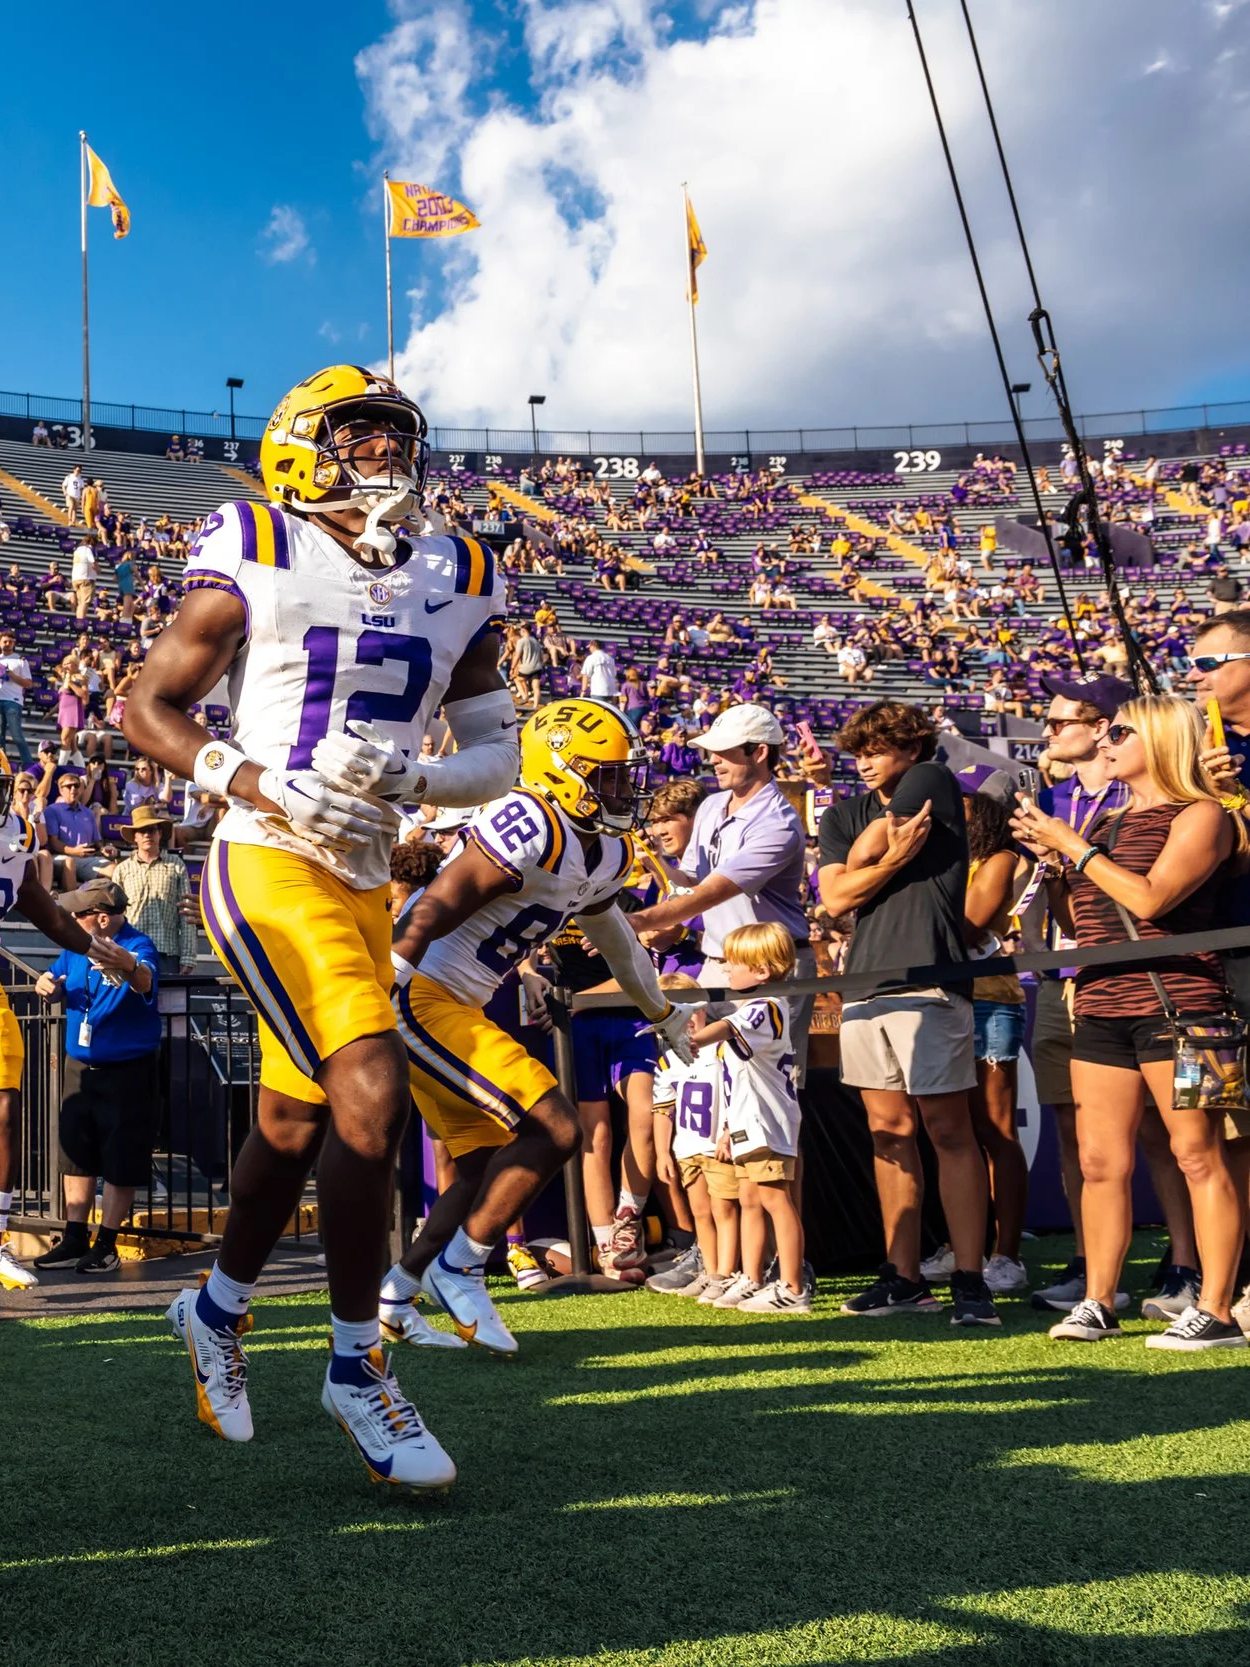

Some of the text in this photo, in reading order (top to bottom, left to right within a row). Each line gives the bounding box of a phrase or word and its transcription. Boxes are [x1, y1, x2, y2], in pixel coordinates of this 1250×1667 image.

[224, 442, 240, 450] 237
[449, 455, 502, 464] 237 238
[594, 458, 639, 478] 238
[731, 457, 786, 466] 238 239
[894, 451, 941, 472] 239
[482, 523, 500, 532] 237
[362, 613, 395, 628] LSU
[286, 626, 433, 770] 12
[1015, 744, 1040, 760] 214
[490, 800, 540, 854] 82
[476, 903, 576, 975] 8
[746, 1008, 765, 1030] 18
[177, 1301, 185, 1327] LSU
